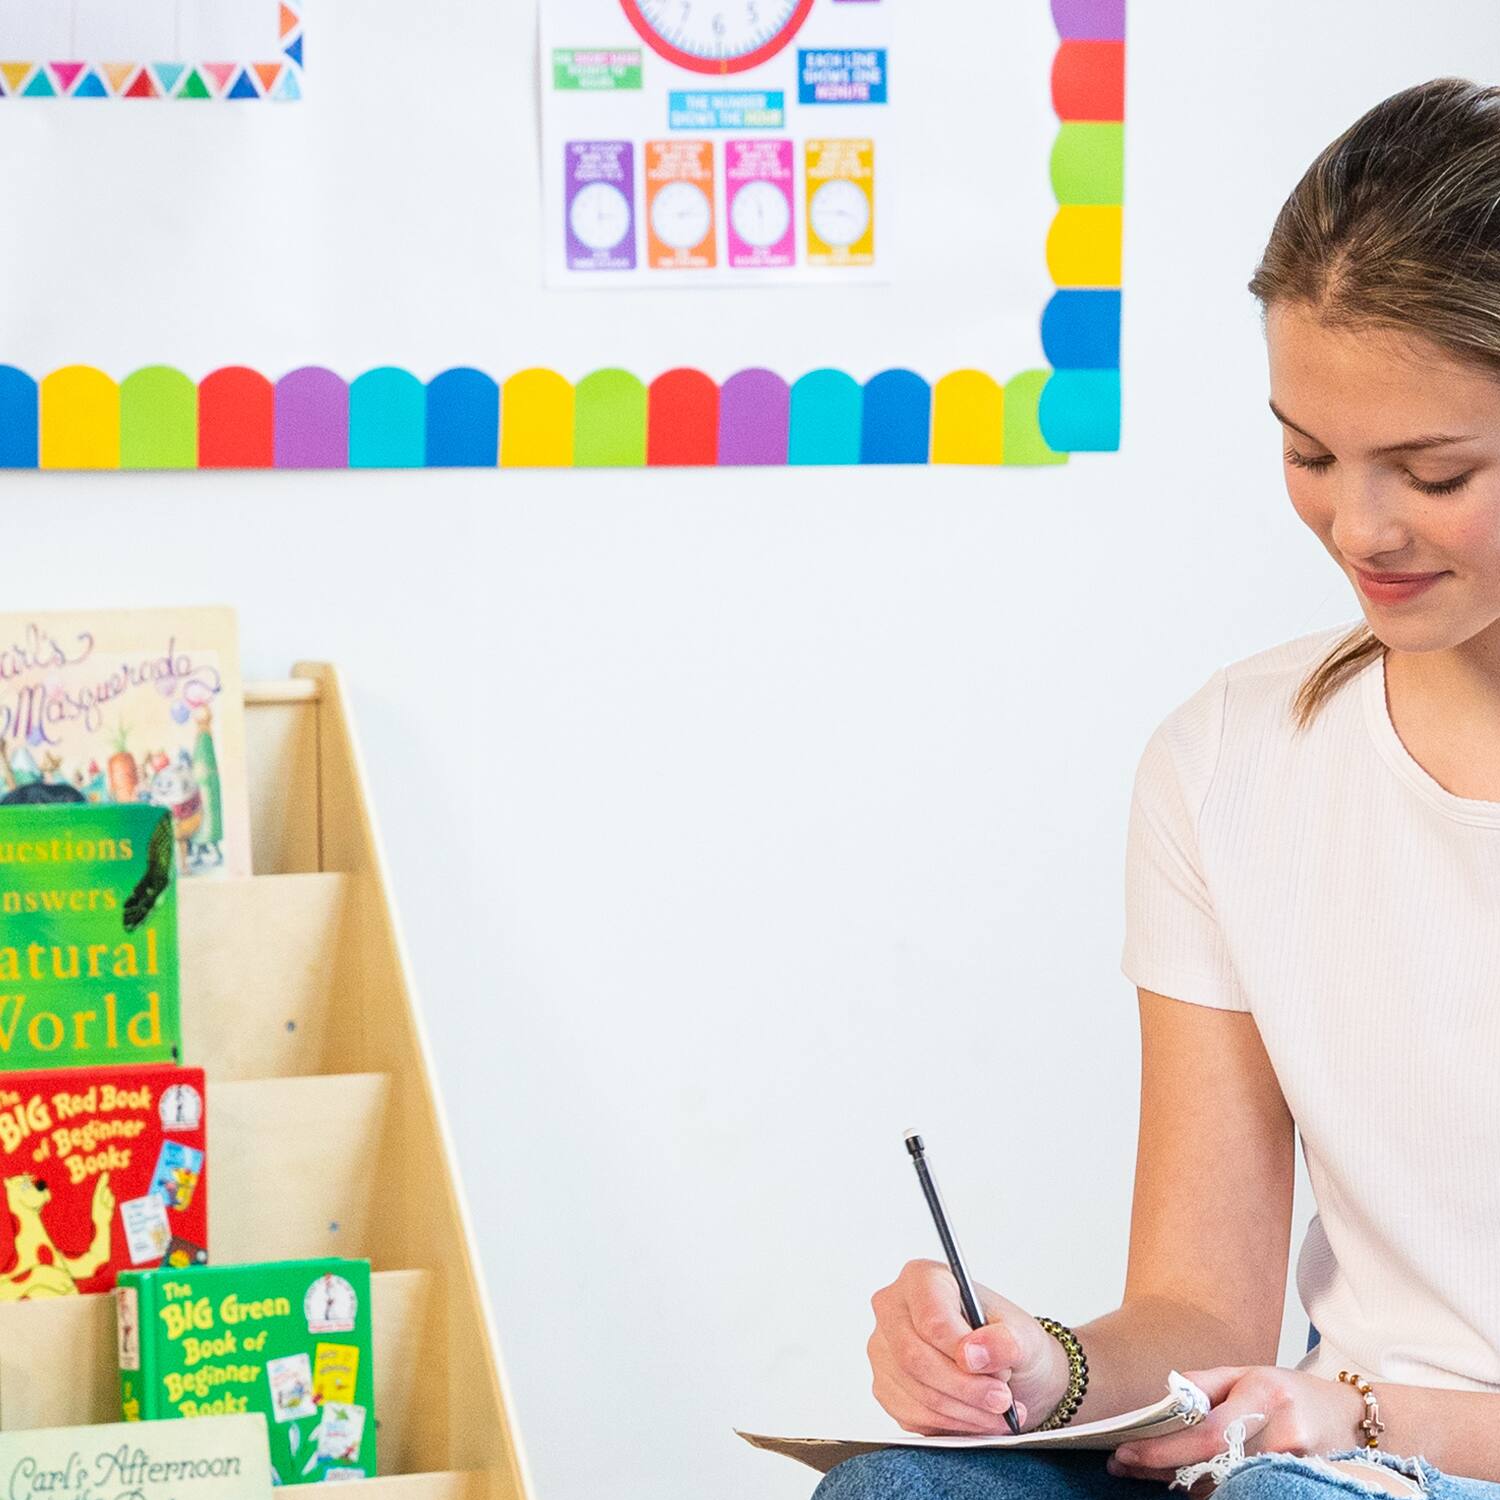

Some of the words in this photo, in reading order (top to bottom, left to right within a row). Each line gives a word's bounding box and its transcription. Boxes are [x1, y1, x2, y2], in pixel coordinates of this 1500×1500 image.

[0, 623, 94, 680] arl's
[0, 832, 133, 864] uestions
[3, 888, 117, 913] nswers
[0, 928, 159, 981] atural
[0, 1095, 52, 1154] BIG
[52, 1086, 97, 1121] Red
[99, 1084, 151, 1112] Book
[33, 1137, 50, 1162] of
[51, 1120, 146, 1158] Beginner
[64, 1145, 132, 1184] Books
[163, 1282, 192, 1301] The
[159, 1297, 214, 1340] BIG
[220, 1294, 290, 1325] Green
[182, 1330, 236, 1366] Book
[243, 1331, 268, 1351] of
[163, 1366, 261, 1403] Beginner
[94, 1444, 241, 1488] Afternoon
